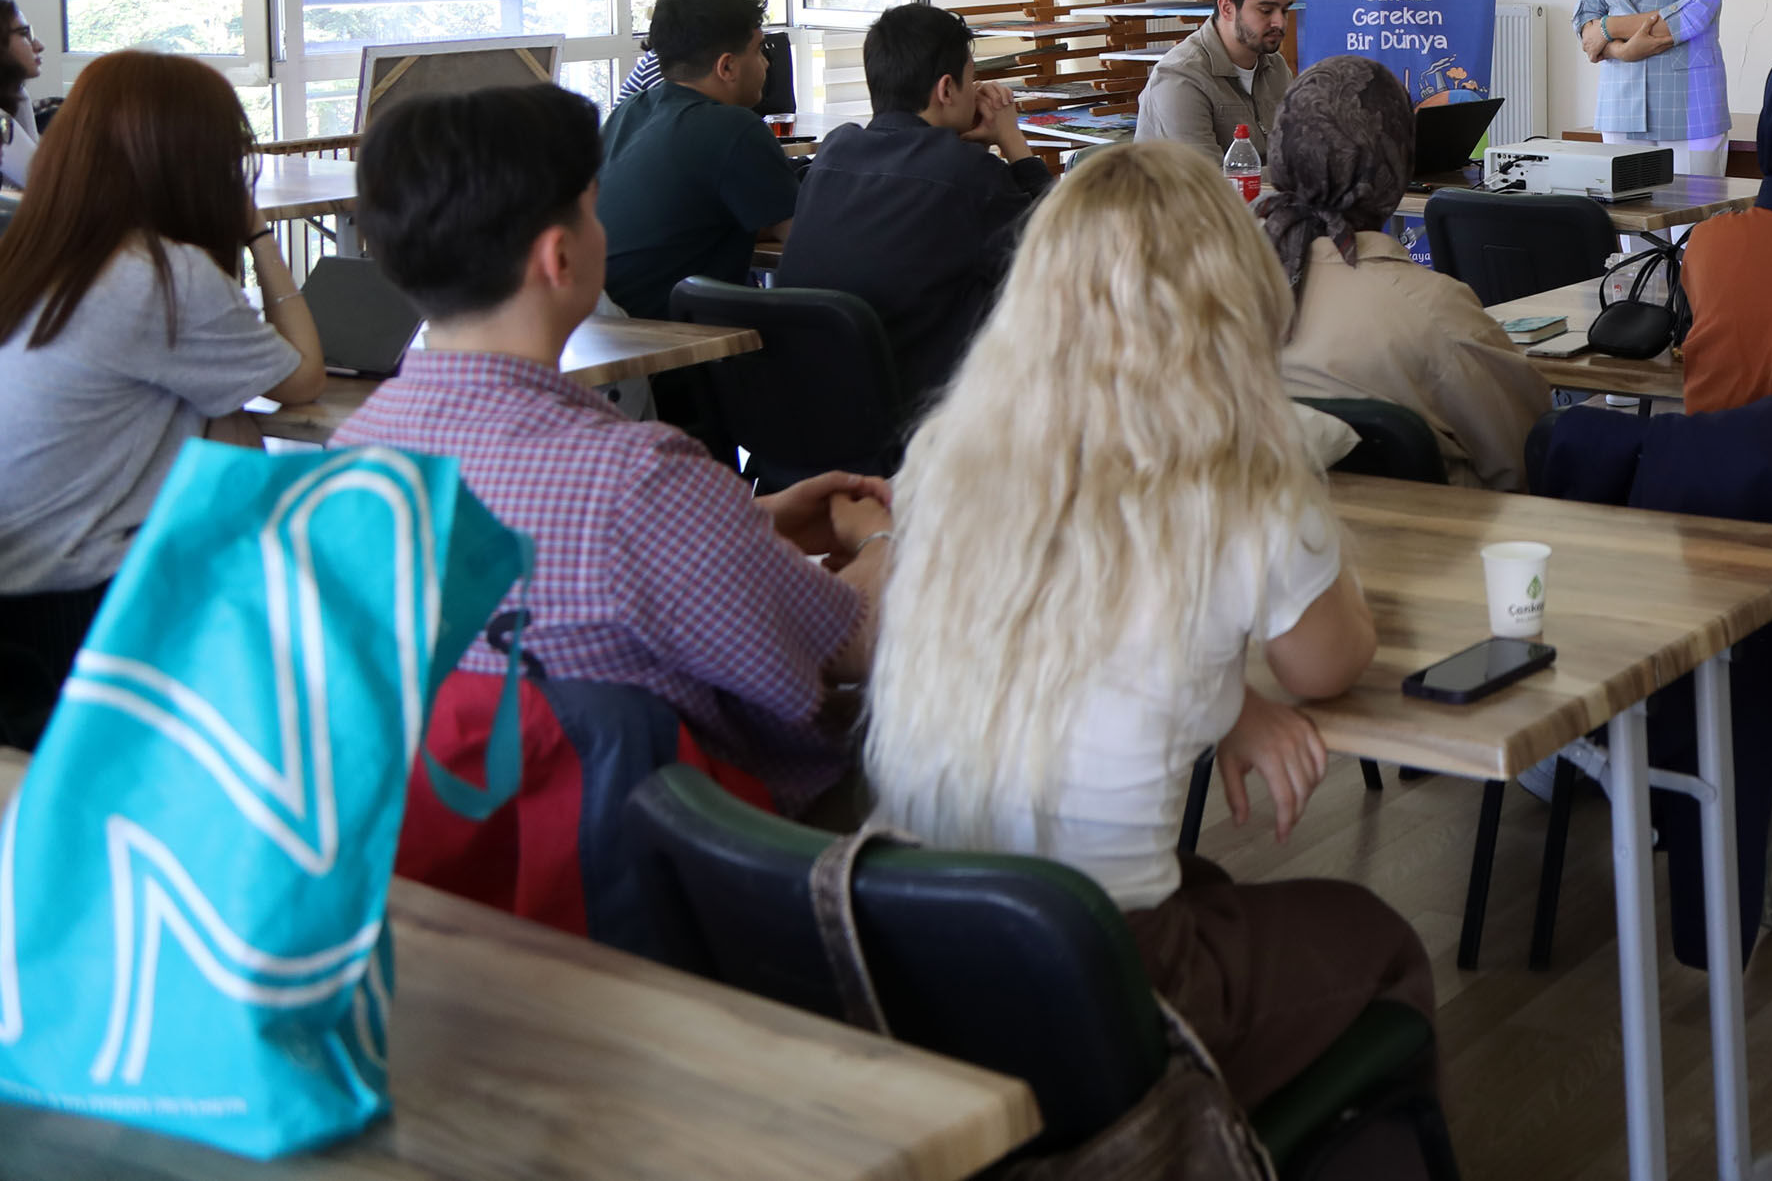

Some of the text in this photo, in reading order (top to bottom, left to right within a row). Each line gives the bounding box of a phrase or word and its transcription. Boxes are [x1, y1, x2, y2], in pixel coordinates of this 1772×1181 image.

[1353, 7, 1442, 26] Gereken
[1347, 29, 1447, 54] Bir Dünya
